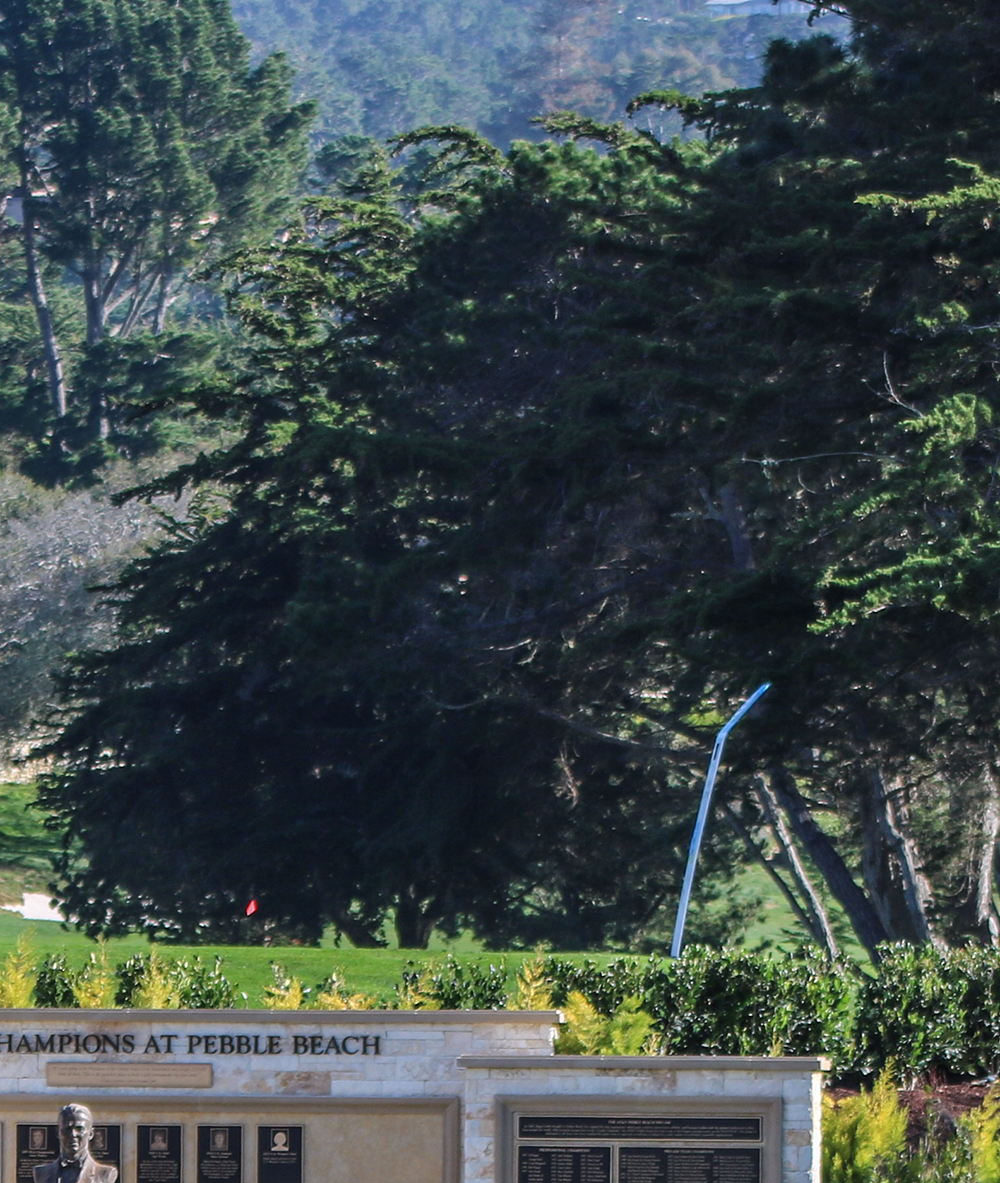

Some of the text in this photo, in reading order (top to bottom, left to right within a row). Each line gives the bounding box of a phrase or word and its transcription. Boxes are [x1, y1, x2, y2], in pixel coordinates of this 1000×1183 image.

[143, 1034, 178, 1053] AT
[186, 1035, 282, 1054] PEBBLE
[292, 1035, 381, 1055] BEACH
